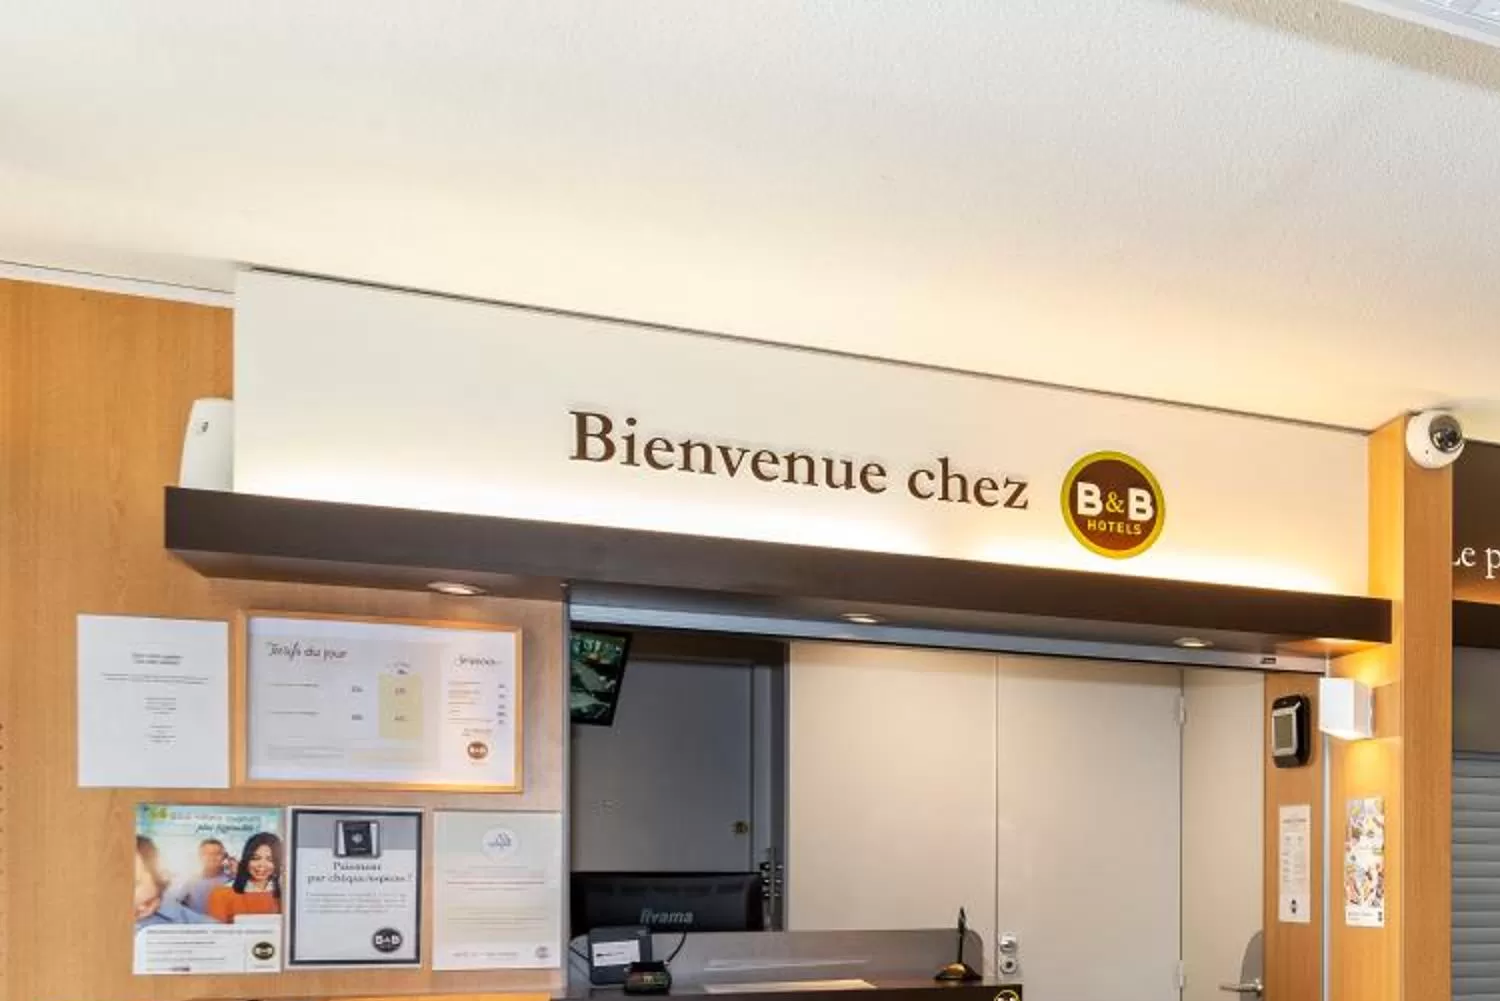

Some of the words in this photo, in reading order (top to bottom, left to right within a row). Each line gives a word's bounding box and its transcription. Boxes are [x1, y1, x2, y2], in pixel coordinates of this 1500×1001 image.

[567, 409, 889, 496] Bienvenue
[906, 454, 1031, 513] chez
[1076, 480, 1155, 522] B&B
[1086, 518, 1143, 536] HOTELS
